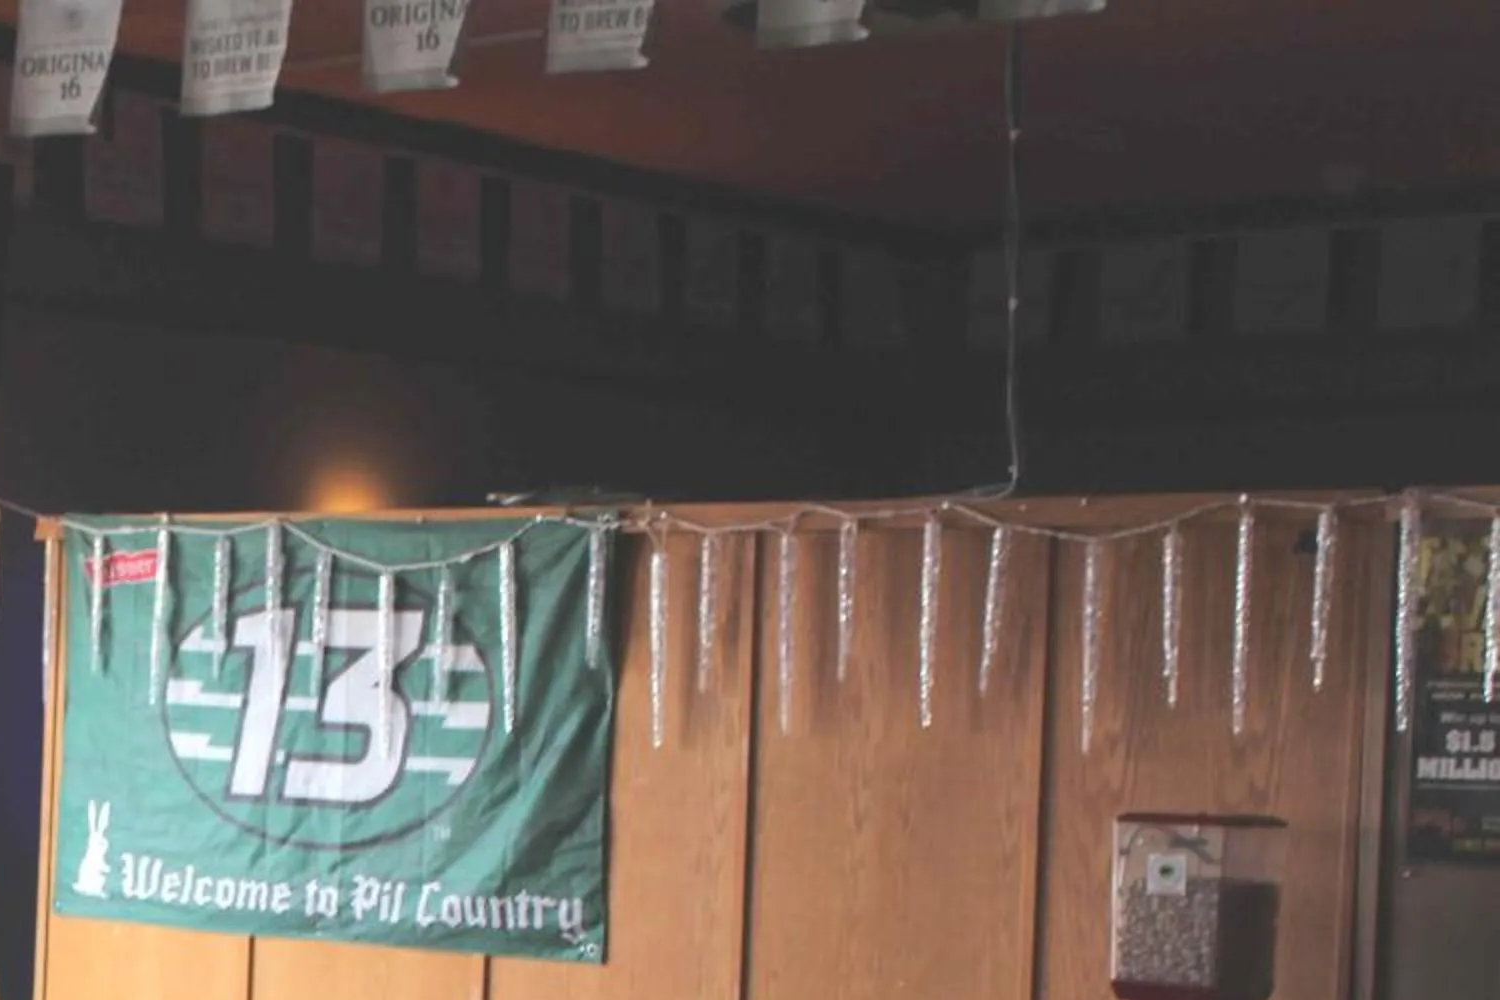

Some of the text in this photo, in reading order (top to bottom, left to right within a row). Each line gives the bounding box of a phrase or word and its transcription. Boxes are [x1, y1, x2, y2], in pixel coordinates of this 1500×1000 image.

[416, 26, 440, 51] 16
[60, 77, 82, 101] 16
[228, 606, 428, 804] 13
[120, 852, 588, 945] Welcome to Pil Country
